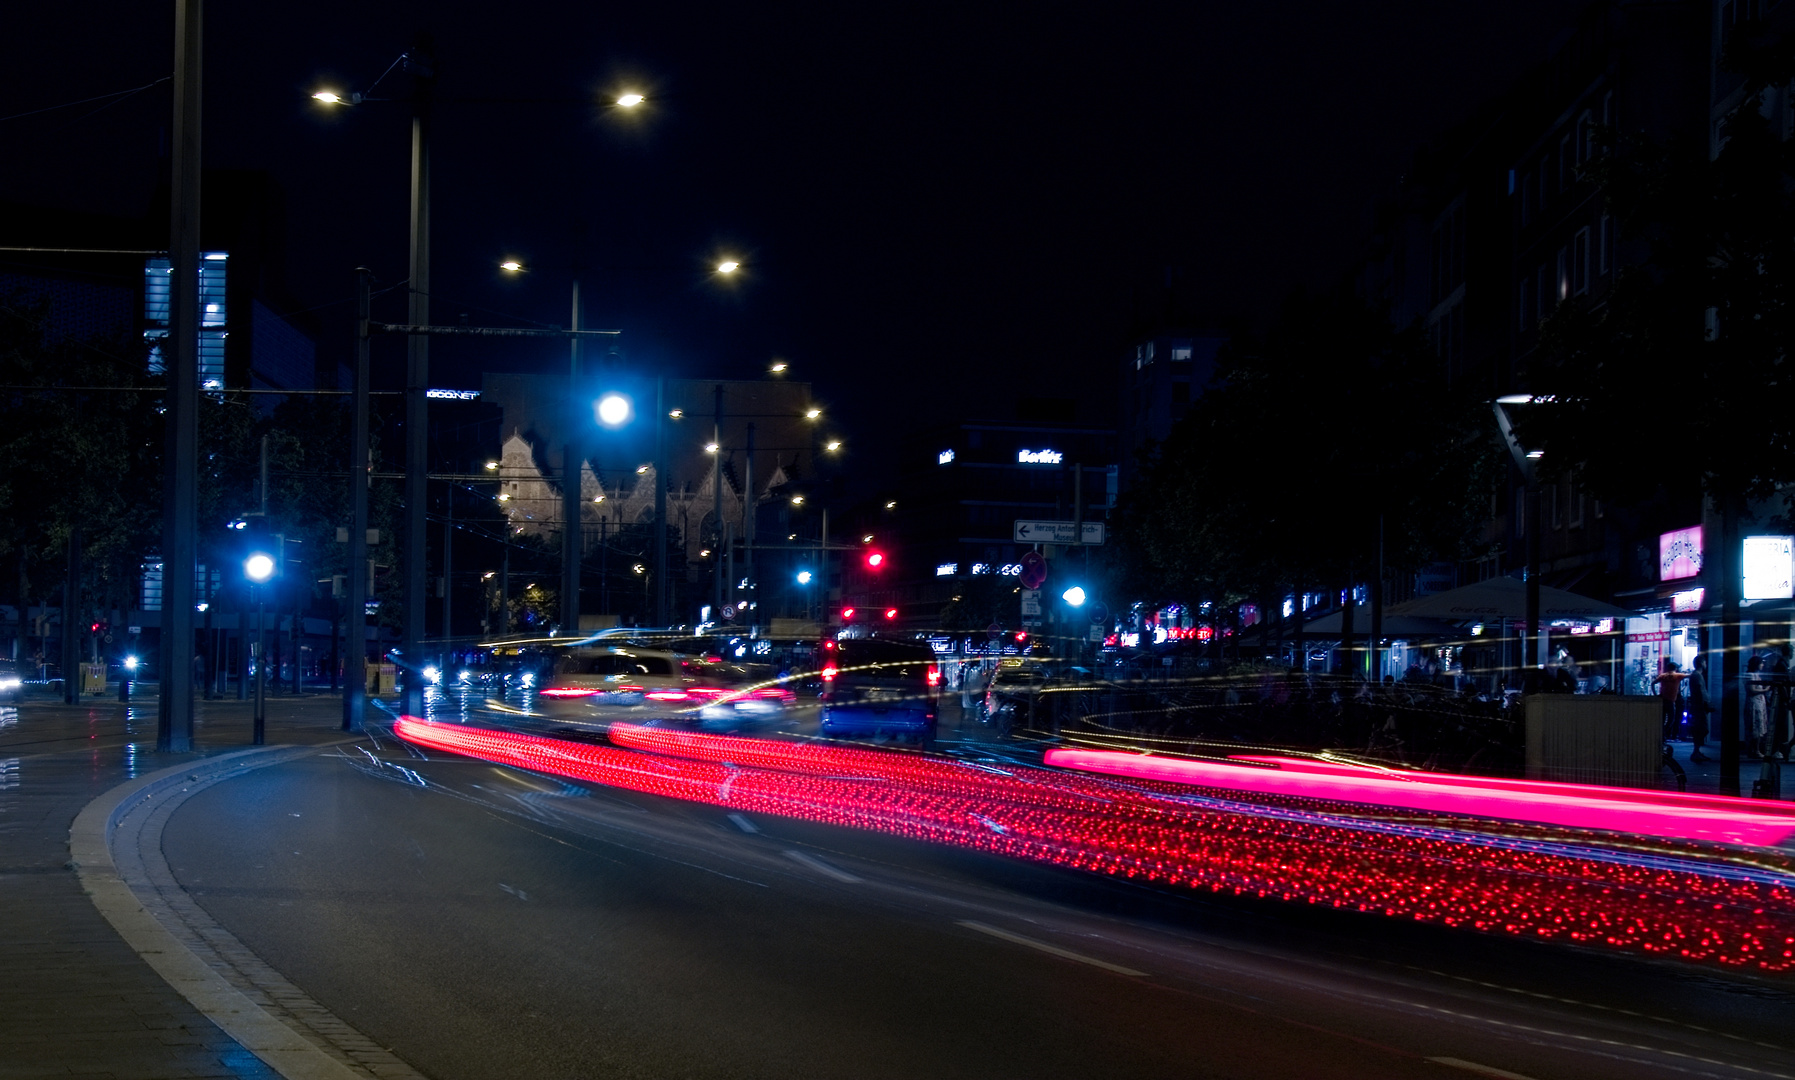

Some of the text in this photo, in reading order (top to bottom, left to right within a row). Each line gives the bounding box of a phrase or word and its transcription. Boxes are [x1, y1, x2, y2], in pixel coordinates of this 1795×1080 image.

[1018, 448, 1063, 464] Berlitz
[1034, 523, 1056, 534] Herzog
[1057, 524, 1075, 533] Anton
[1053, 533, 1076, 542] Museu
